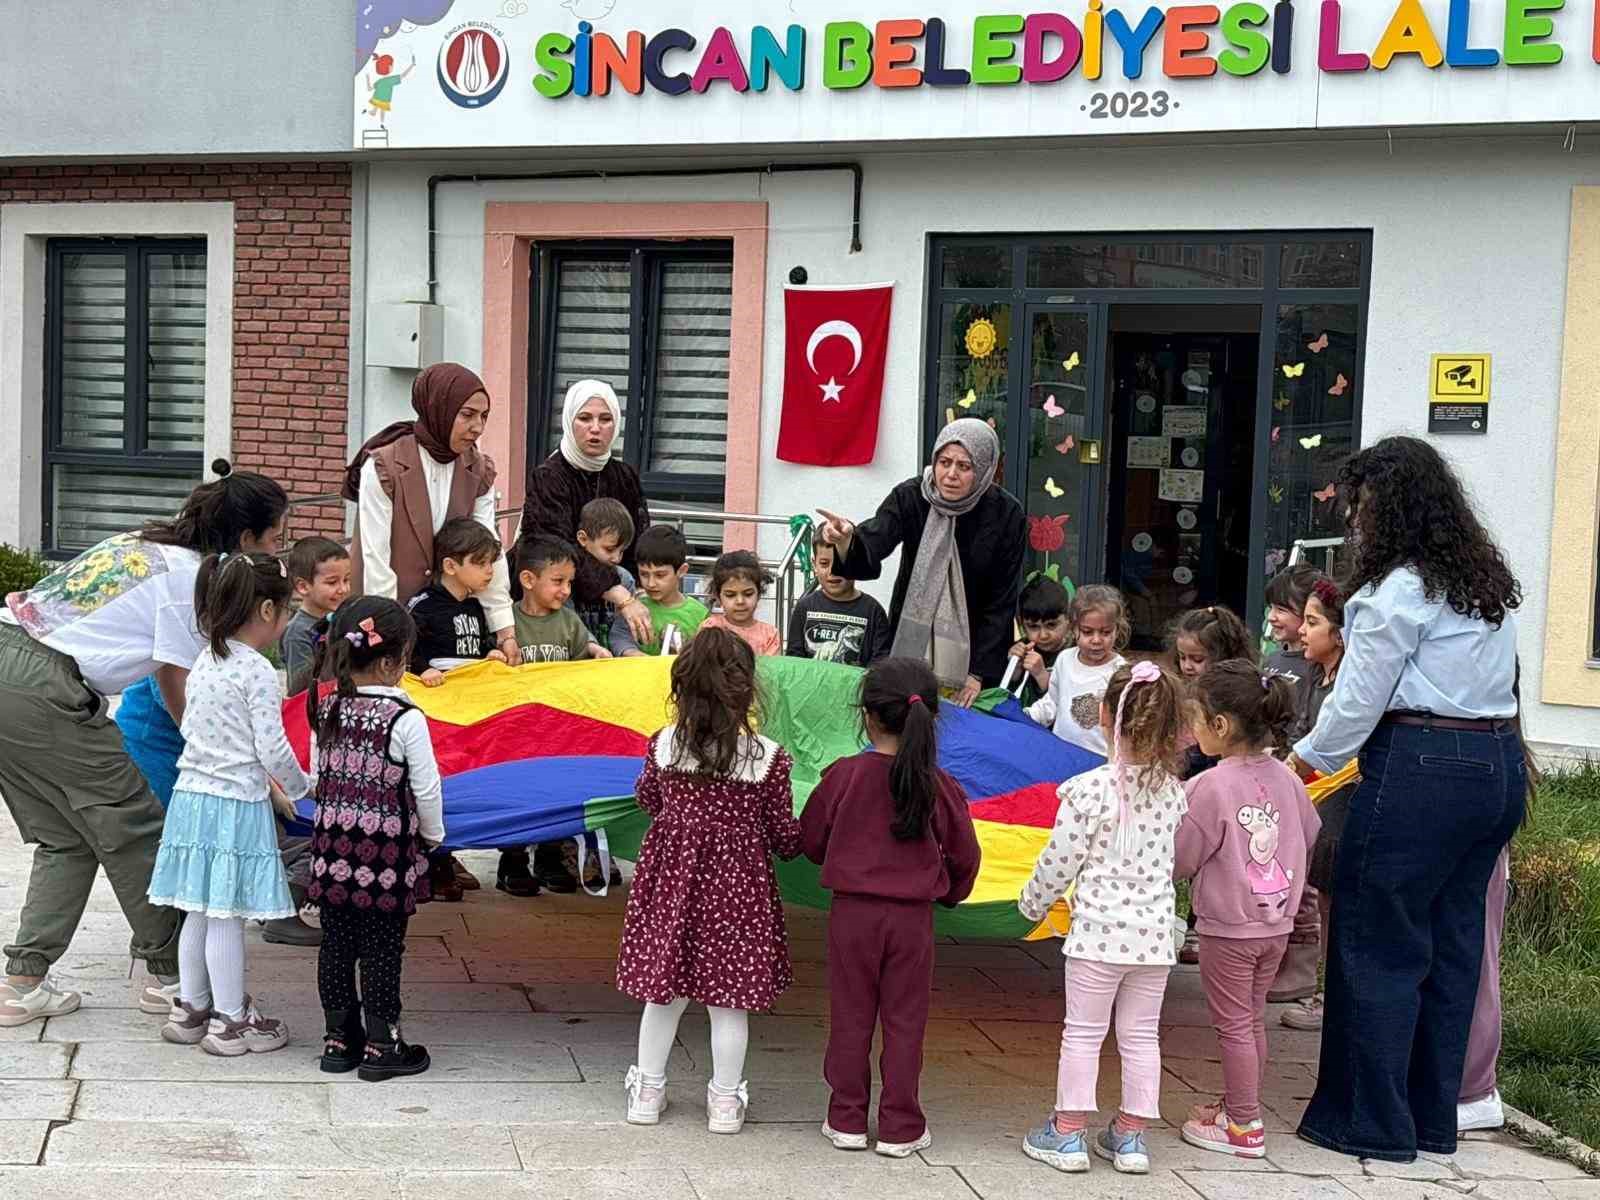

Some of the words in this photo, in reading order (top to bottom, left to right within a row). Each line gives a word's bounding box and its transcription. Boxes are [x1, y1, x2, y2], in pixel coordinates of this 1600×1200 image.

[532, 21, 806, 98] SİNCAN
[823, 0, 1295, 90] BELEDİYESİ
[1318, 0, 1565, 72] LALE
[812, 628, 838, 641] T-REX
